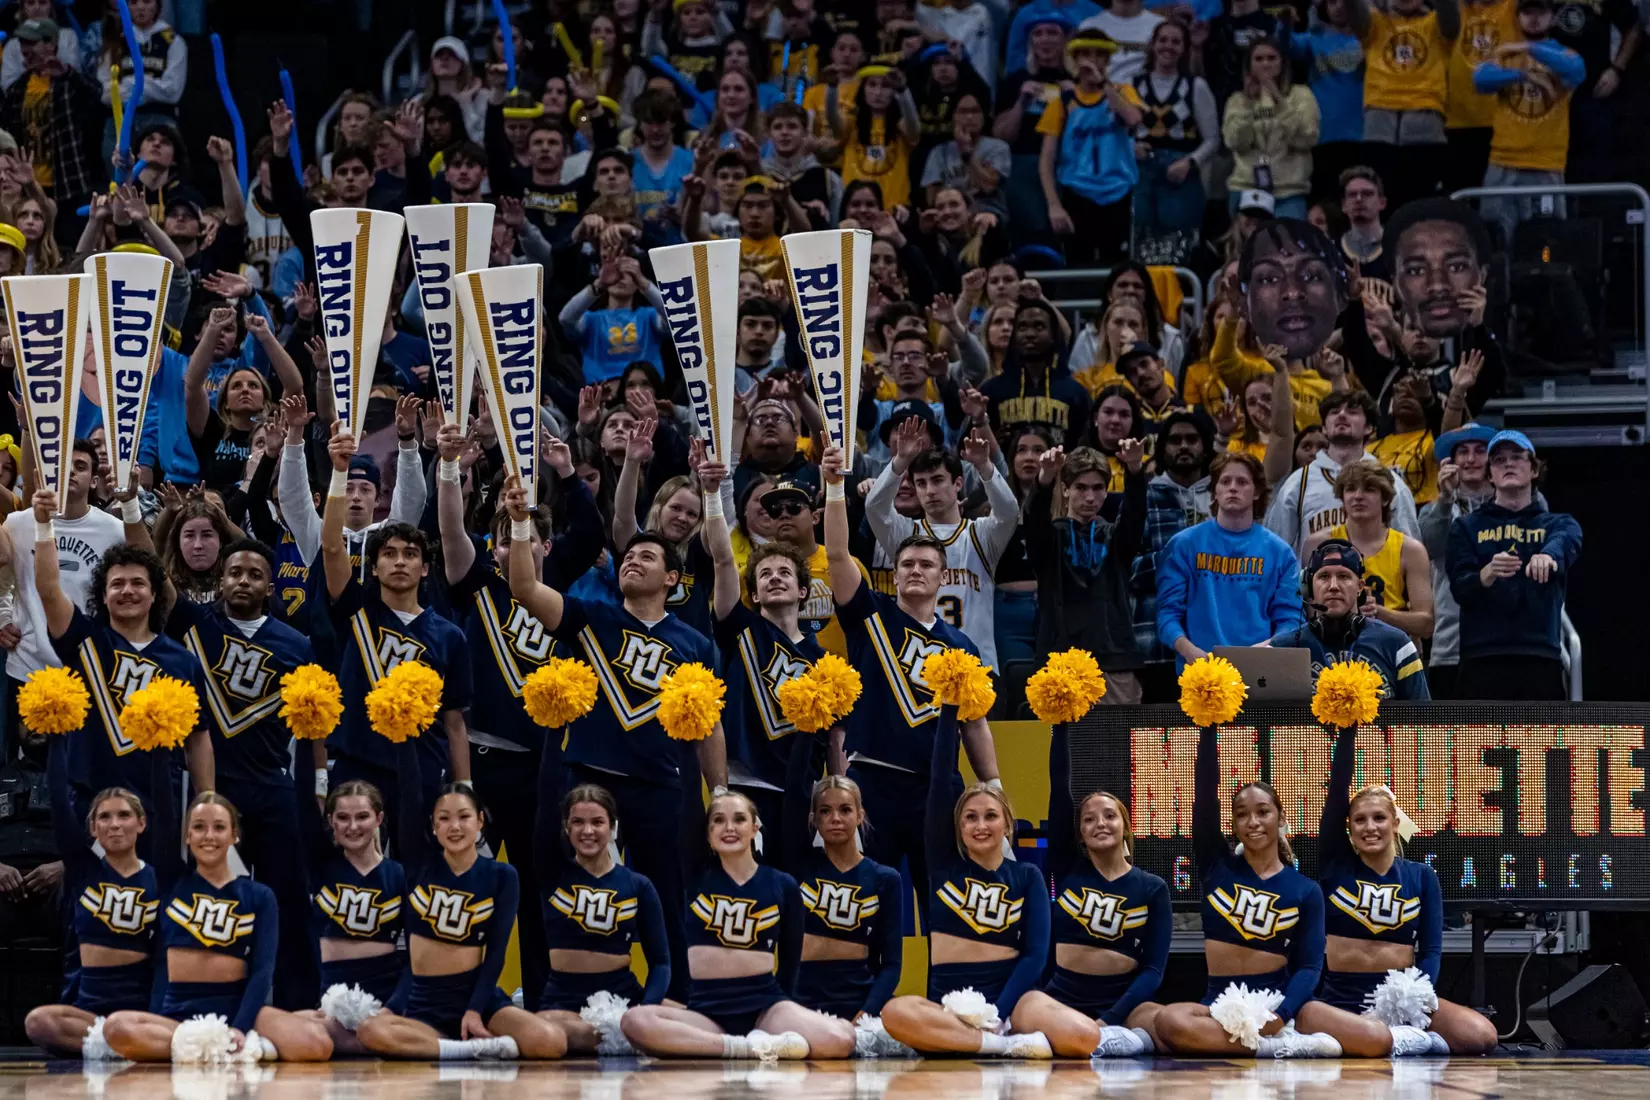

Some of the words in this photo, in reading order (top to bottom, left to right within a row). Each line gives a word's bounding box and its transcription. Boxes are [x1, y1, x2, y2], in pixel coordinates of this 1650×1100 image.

[315, 241, 361, 338] RING
[410, 234, 451, 312] OUT
[111, 279, 157, 358] OUT
[793, 263, 842, 360] RING
[17, 308, 64, 404] RING
[429, 320, 453, 414] RING
[489, 297, 536, 394] RING
[658, 275, 702, 370] RING
[687, 379, 716, 455] OUT
[115, 369, 144, 462] RING
[330, 349, 361, 428] OUT
[36, 415, 61, 493] OUT
[510, 405, 534, 485] OUT
[1308, 508, 1347, 534] MARQU
[54, 536, 99, 567] QUETTE
[1196, 552, 1265, 577] MARQUETTE
[506, 603, 556, 661] MU
[219, 638, 270, 700] MU
[621, 633, 672, 691] MU
[103, 886, 145, 931] MU
[188, 894, 239, 943] MU
[334, 887, 380, 934] MU
[424, 888, 472, 935] MU
[575, 888, 618, 931] MU
[709, 898, 760, 944] MU
[816, 883, 861, 927] MU
[957, 883, 1011, 929] MU
[1081, 890, 1128, 937] MU
[1234, 888, 1282, 937] MU
[1358, 883, 1404, 927] MU
